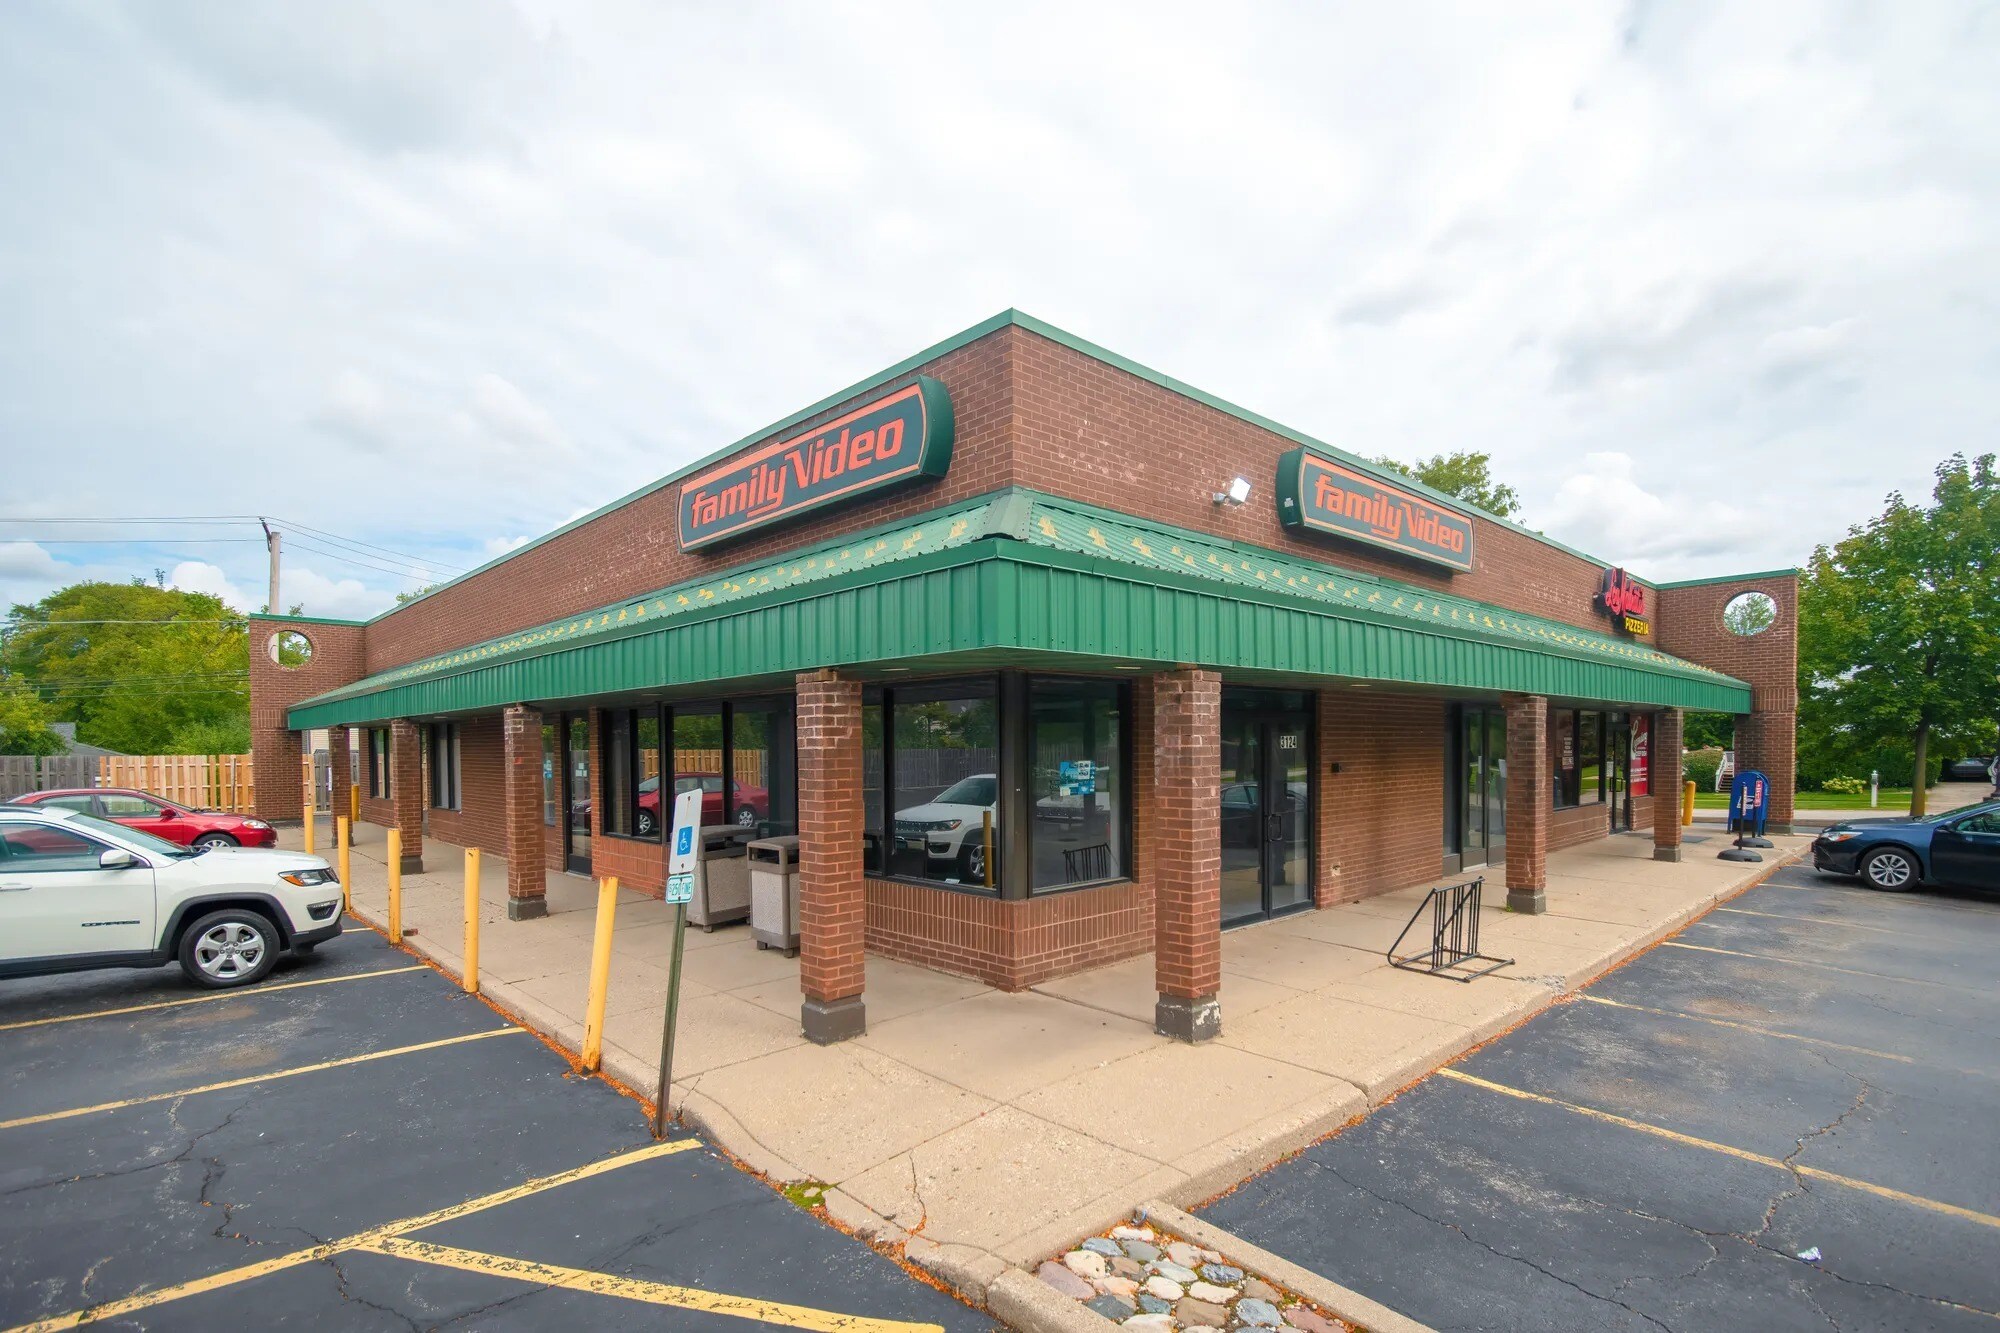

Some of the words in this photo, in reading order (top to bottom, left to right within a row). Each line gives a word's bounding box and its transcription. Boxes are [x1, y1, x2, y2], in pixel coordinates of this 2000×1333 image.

[691, 463, 788, 528] family
[784, 418, 905, 489] Video
[1314, 473, 1401, 539] family
[1400, 502, 1464, 553] Video
[1281, 736, 1297, 748] 3124
